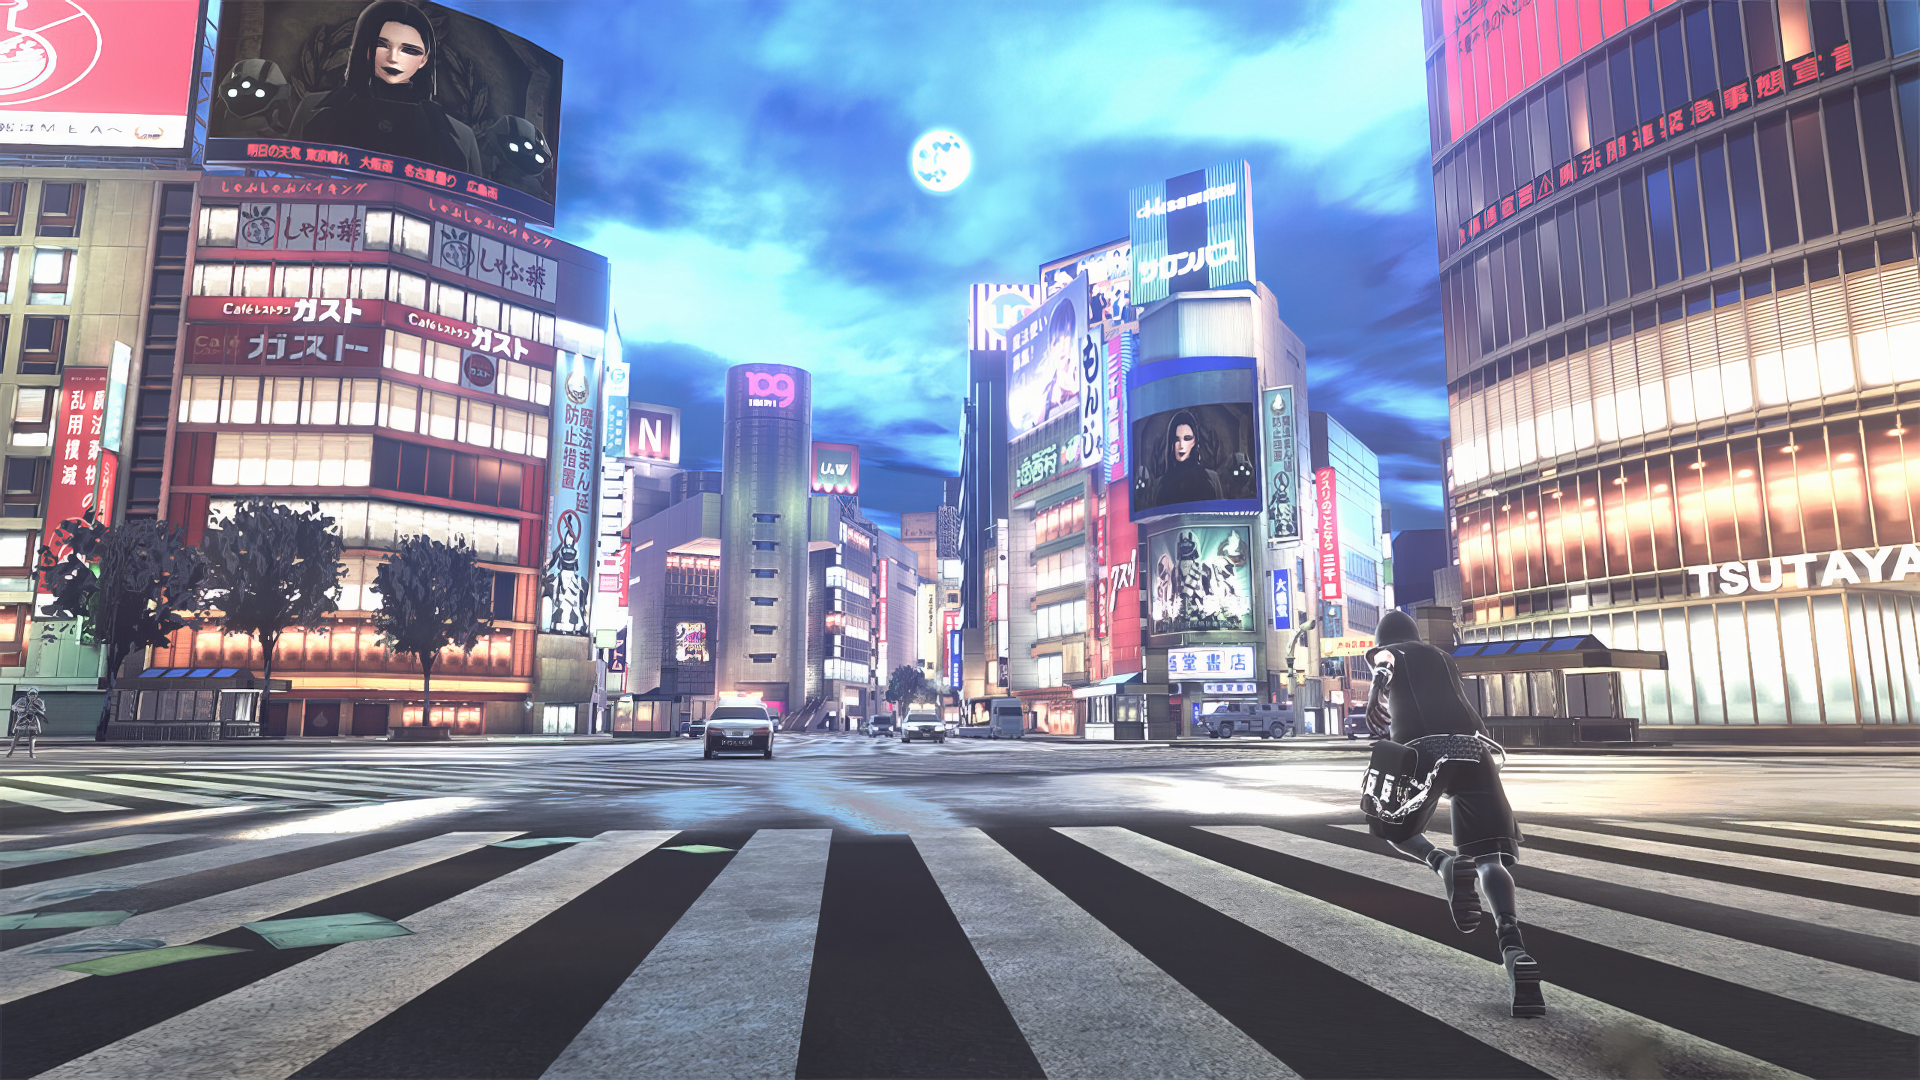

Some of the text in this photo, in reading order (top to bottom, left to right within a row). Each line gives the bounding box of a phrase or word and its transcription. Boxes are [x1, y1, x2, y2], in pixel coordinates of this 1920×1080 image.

[292, 298, 362, 324] ガスト
[471, 326, 529, 362] ガスト
[745, 371, 795, 408] 109
[638, 417, 662, 453] N
[1688, 543, 1920, 598] TSUTAYA
